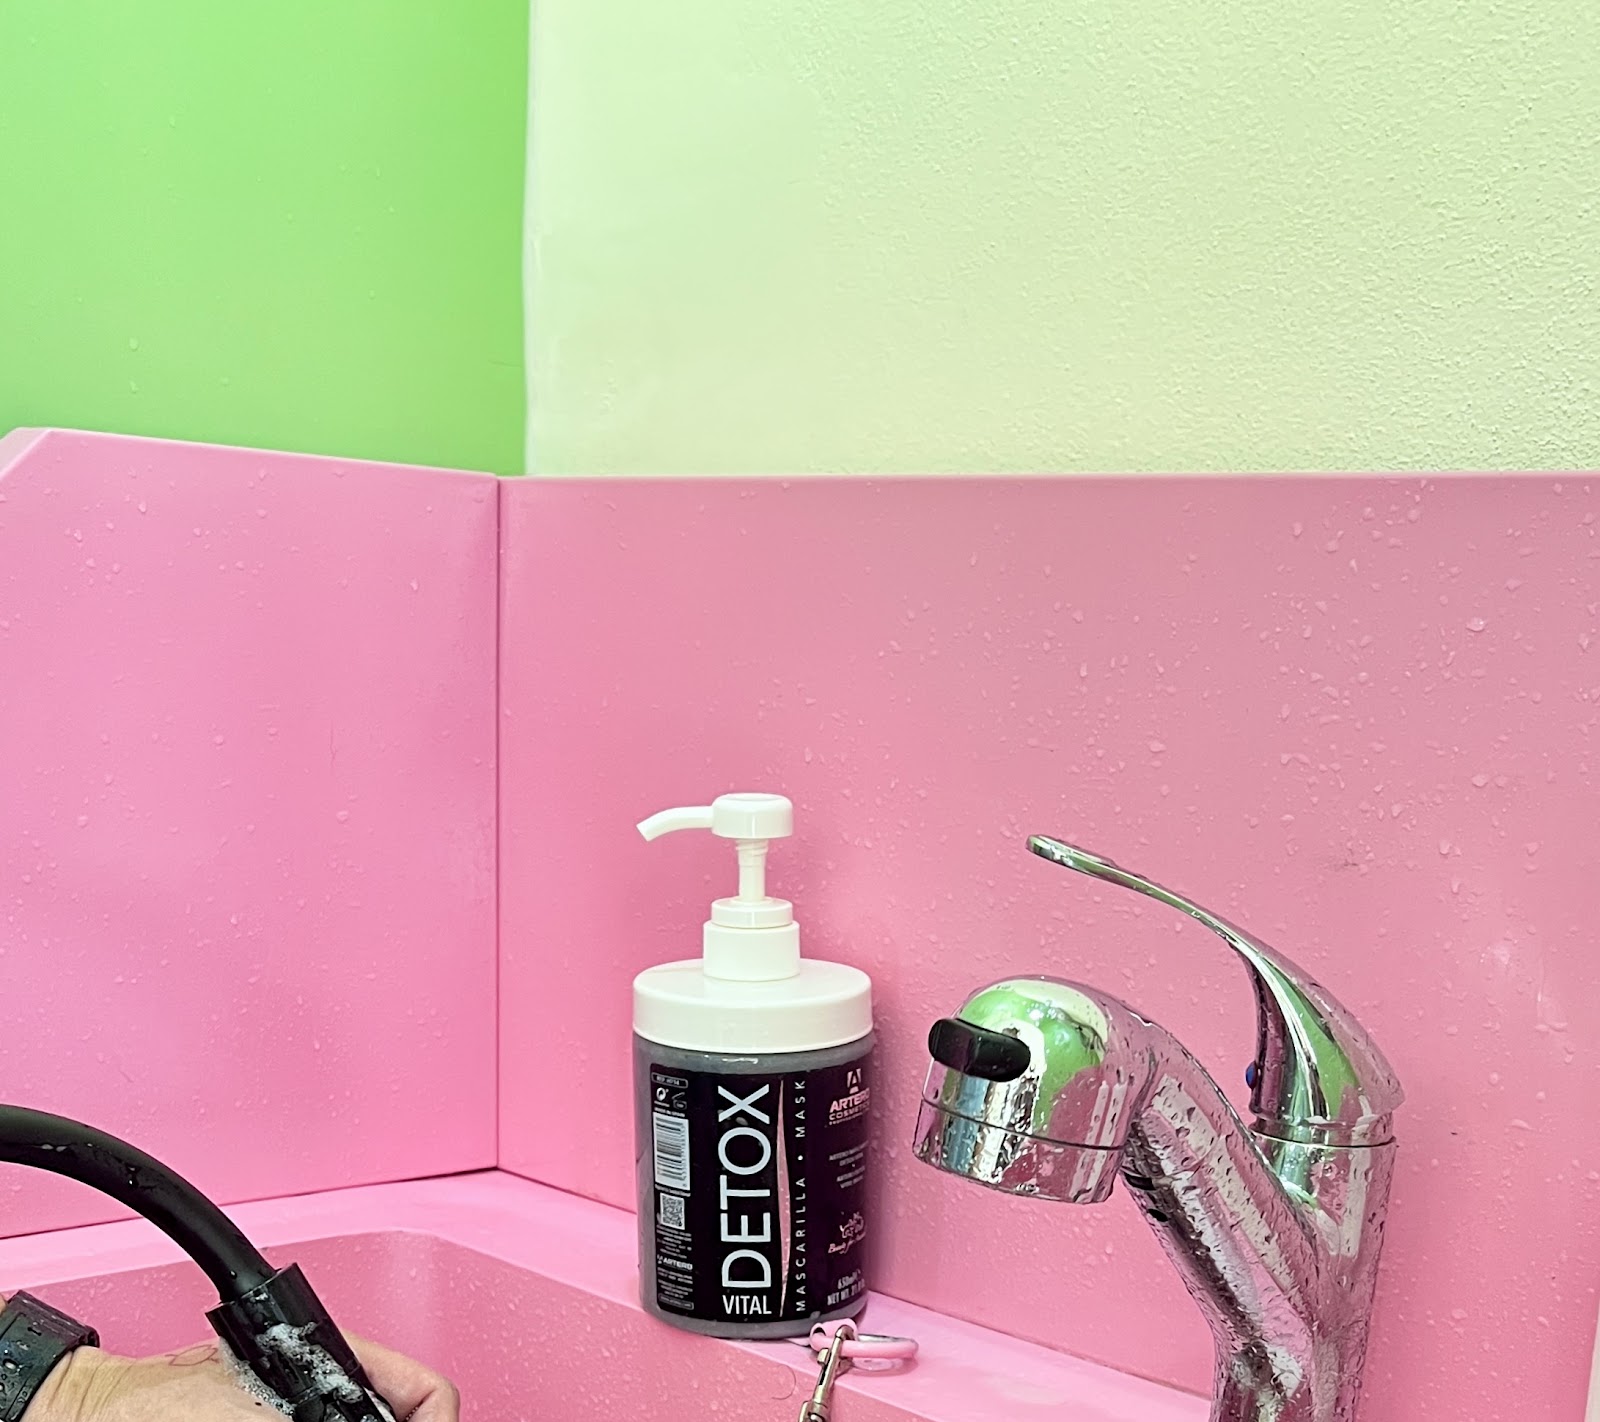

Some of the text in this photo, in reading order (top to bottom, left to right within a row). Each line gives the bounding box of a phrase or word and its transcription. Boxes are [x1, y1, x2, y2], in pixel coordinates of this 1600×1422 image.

[829, 1087, 870, 1113] ARTERO
[717, 1083, 772, 1288] DETOX
[794, 1080, 806, 1312] MASCARILLA MASK
[721, 1294, 773, 1315] VITAL
